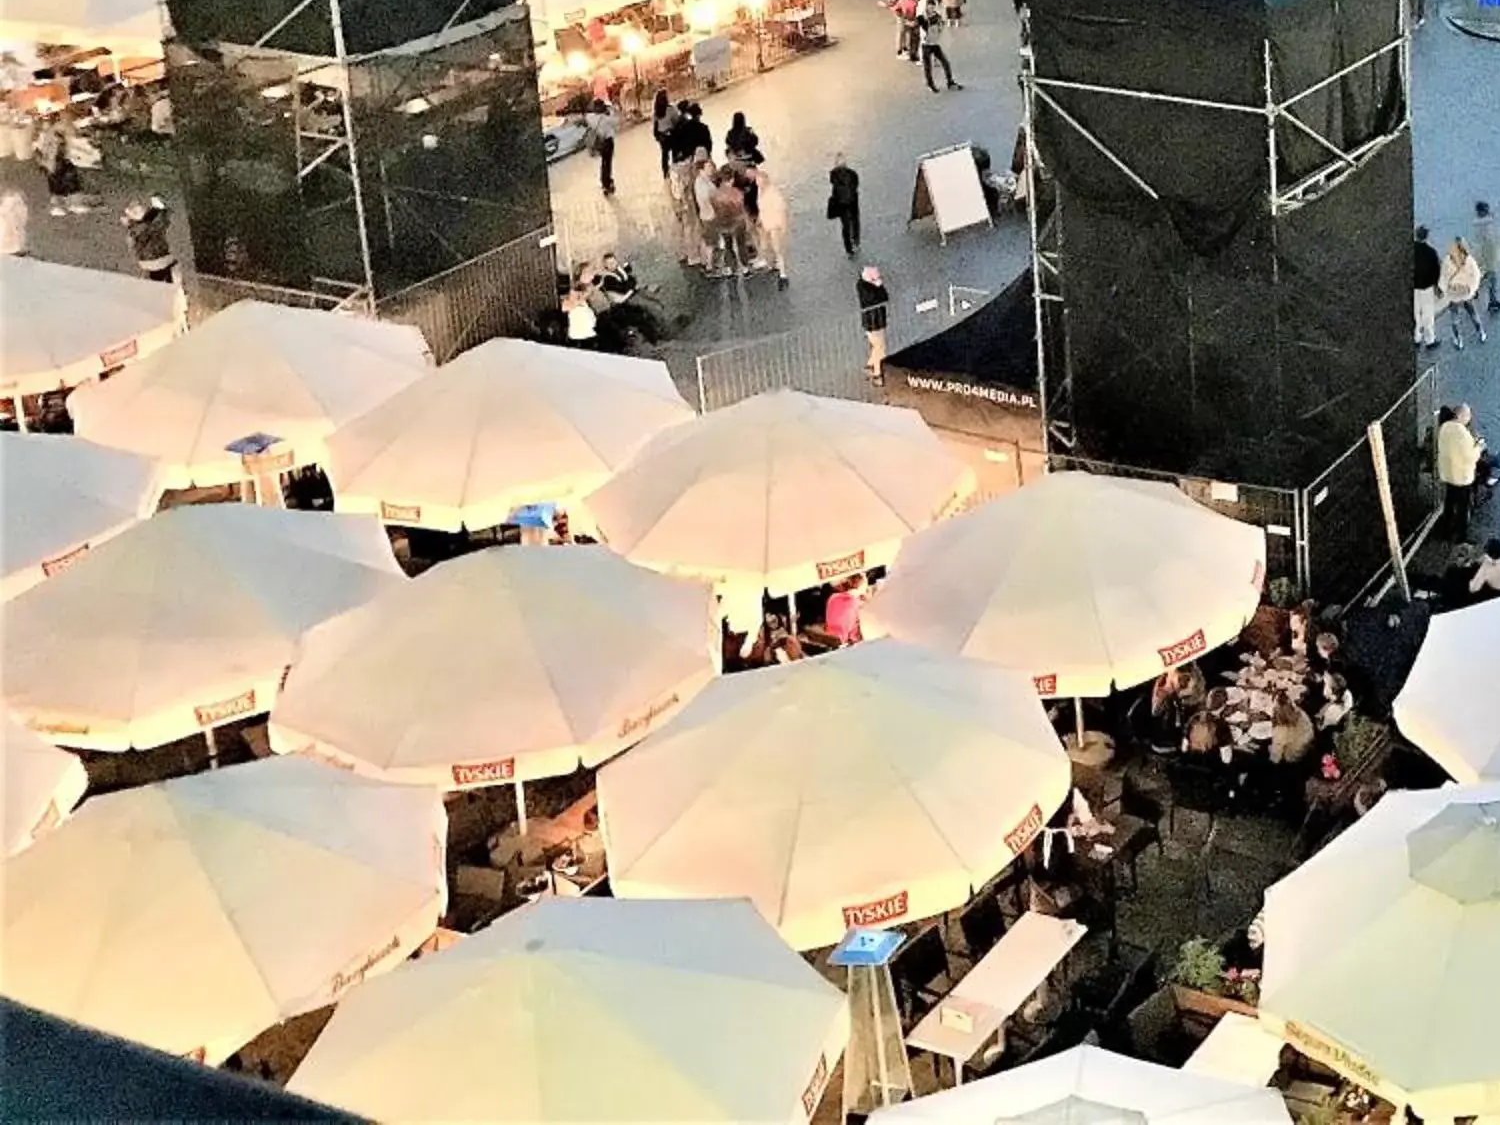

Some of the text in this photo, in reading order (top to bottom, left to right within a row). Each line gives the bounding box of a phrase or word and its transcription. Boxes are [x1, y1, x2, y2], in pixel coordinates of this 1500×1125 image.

[907, 375, 1037, 408] WWW.PRO4MEDIA.PL
[818, 552, 863, 579] TYSKIE
[1159, 633, 1205, 666] TYSKIE
[454, 759, 513, 784] TYSKIE
[844, 893, 907, 928] TYSKIE
